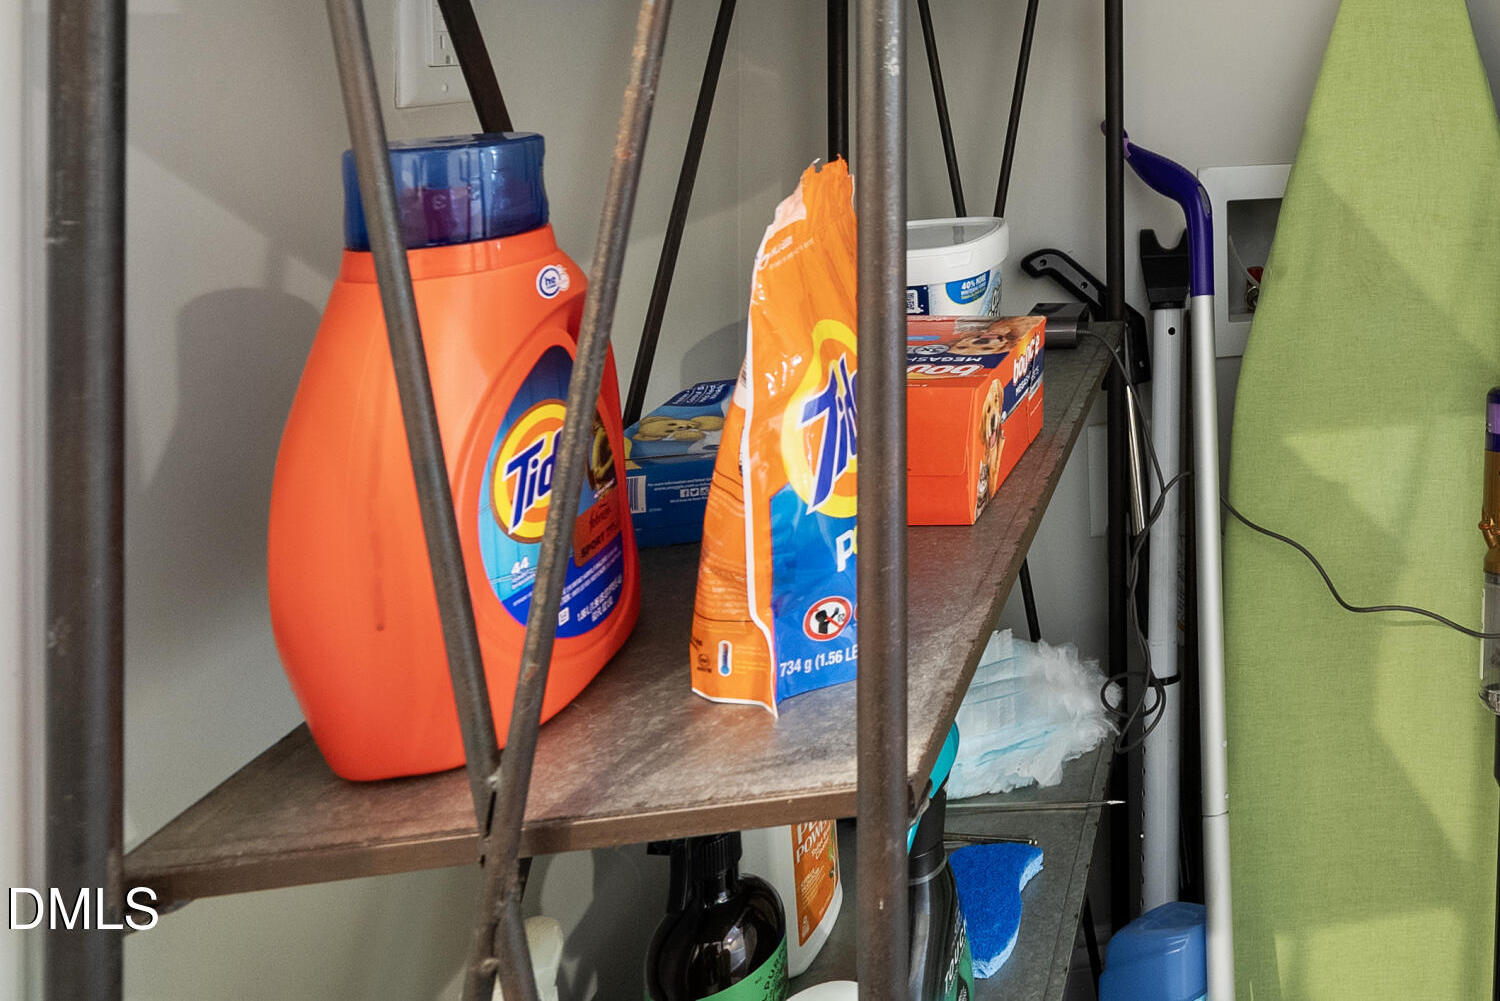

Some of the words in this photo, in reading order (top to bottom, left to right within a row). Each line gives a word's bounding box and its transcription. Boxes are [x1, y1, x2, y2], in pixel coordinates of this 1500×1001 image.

[779, 657, 802, 678] 734
[804, 659, 812, 674] g
[815, 648, 844, 671] (1.56
